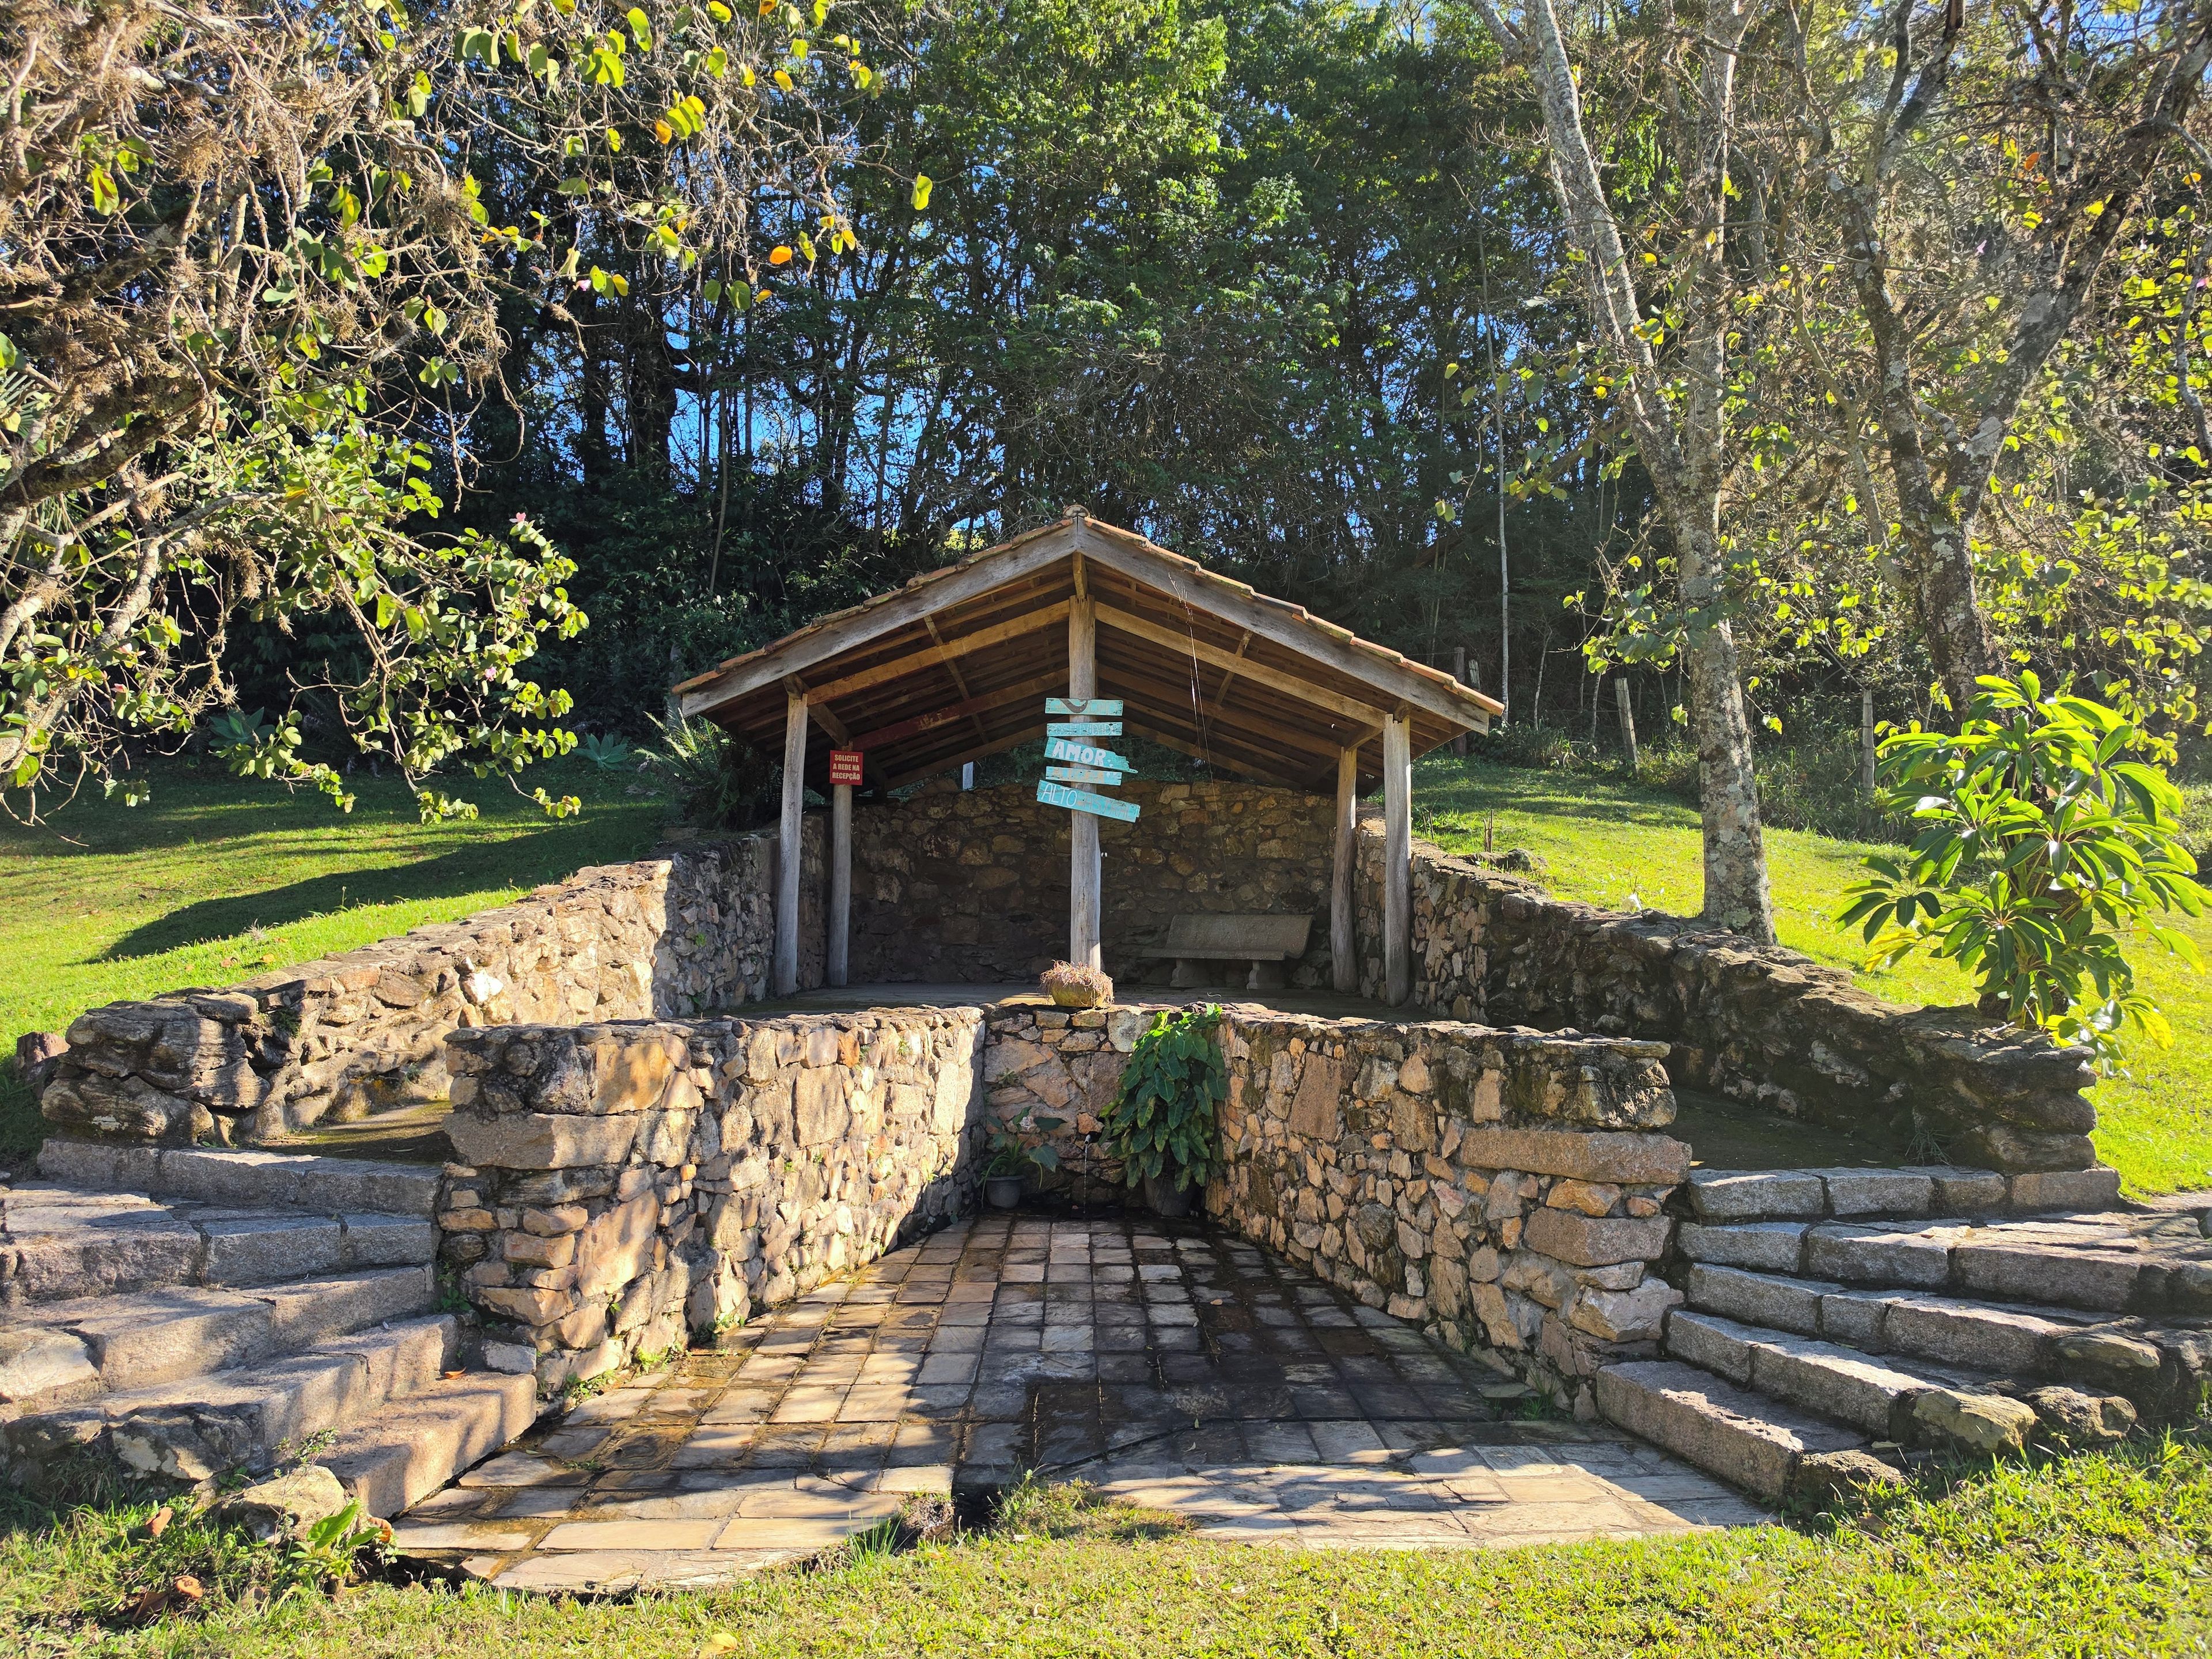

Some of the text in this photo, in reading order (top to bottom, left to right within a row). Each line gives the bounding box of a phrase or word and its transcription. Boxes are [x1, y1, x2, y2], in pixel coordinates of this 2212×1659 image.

[1052, 741, 1106, 767] AMOR
[832, 772, 861, 781] RECEPÇÃO
[1040, 783, 1077, 807] ALTO
